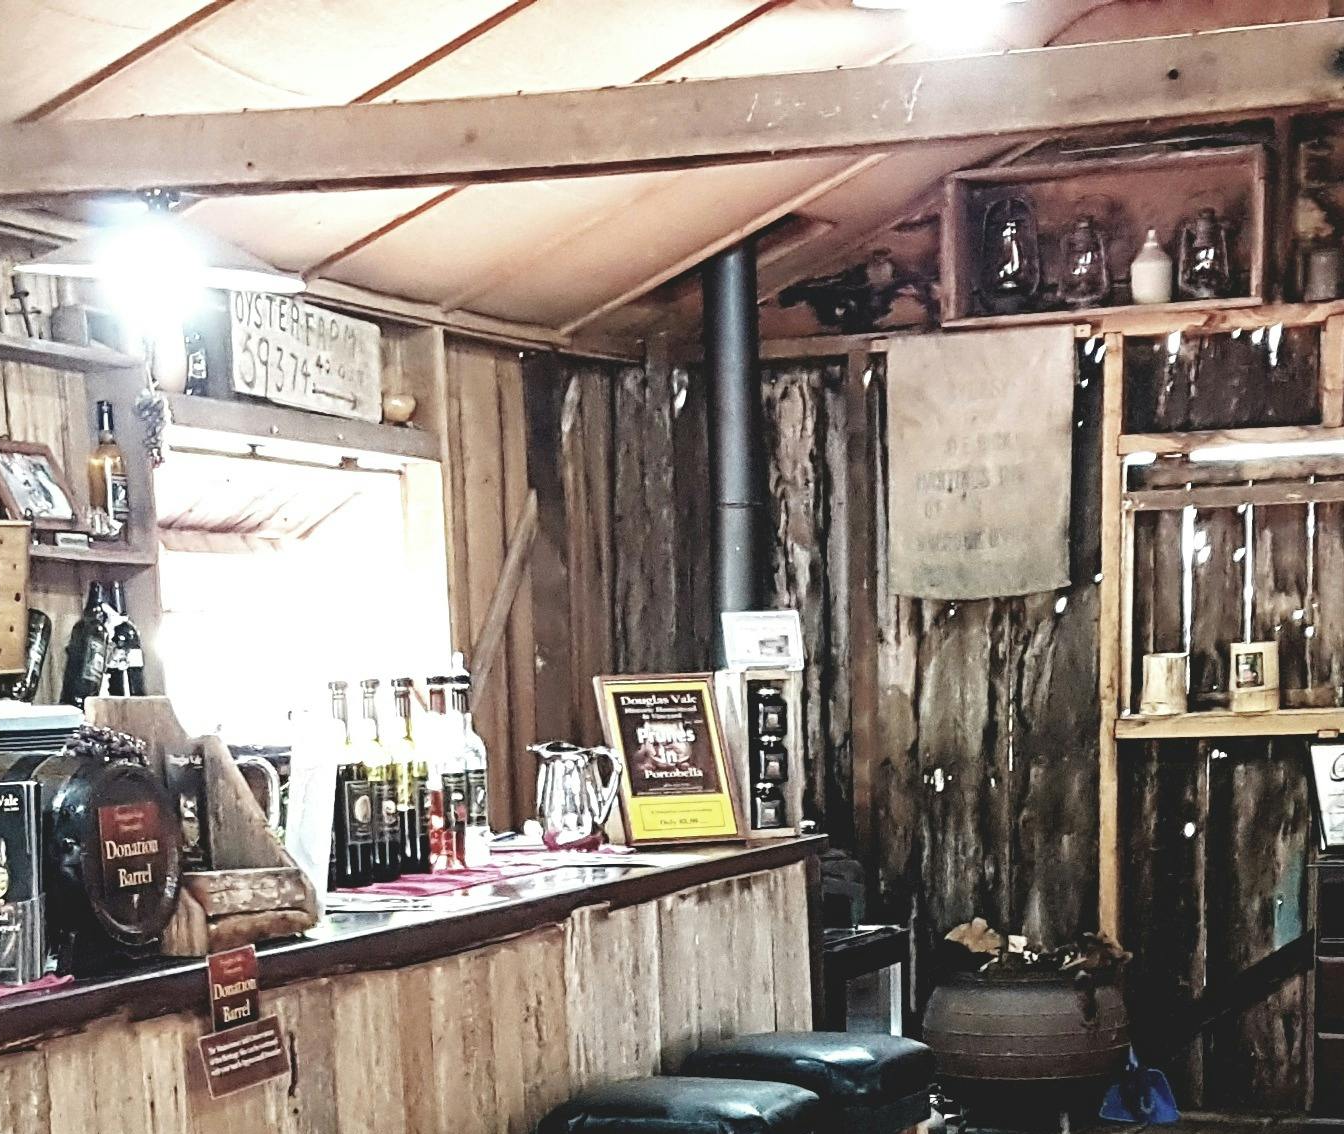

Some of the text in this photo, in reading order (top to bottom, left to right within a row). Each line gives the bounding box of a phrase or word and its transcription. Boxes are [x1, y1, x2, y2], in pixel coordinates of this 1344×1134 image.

[239, 332, 311, 399] 59374
[620, 693, 698, 708] Douglas Vale
[644, 767, 704, 779] Portobella
[105, 838, 159, 860] Donation
[117, 863, 153, 888] Barrel
[214, 977, 257, 1001] Donation
[222, 998, 251, 1023] Barrel
